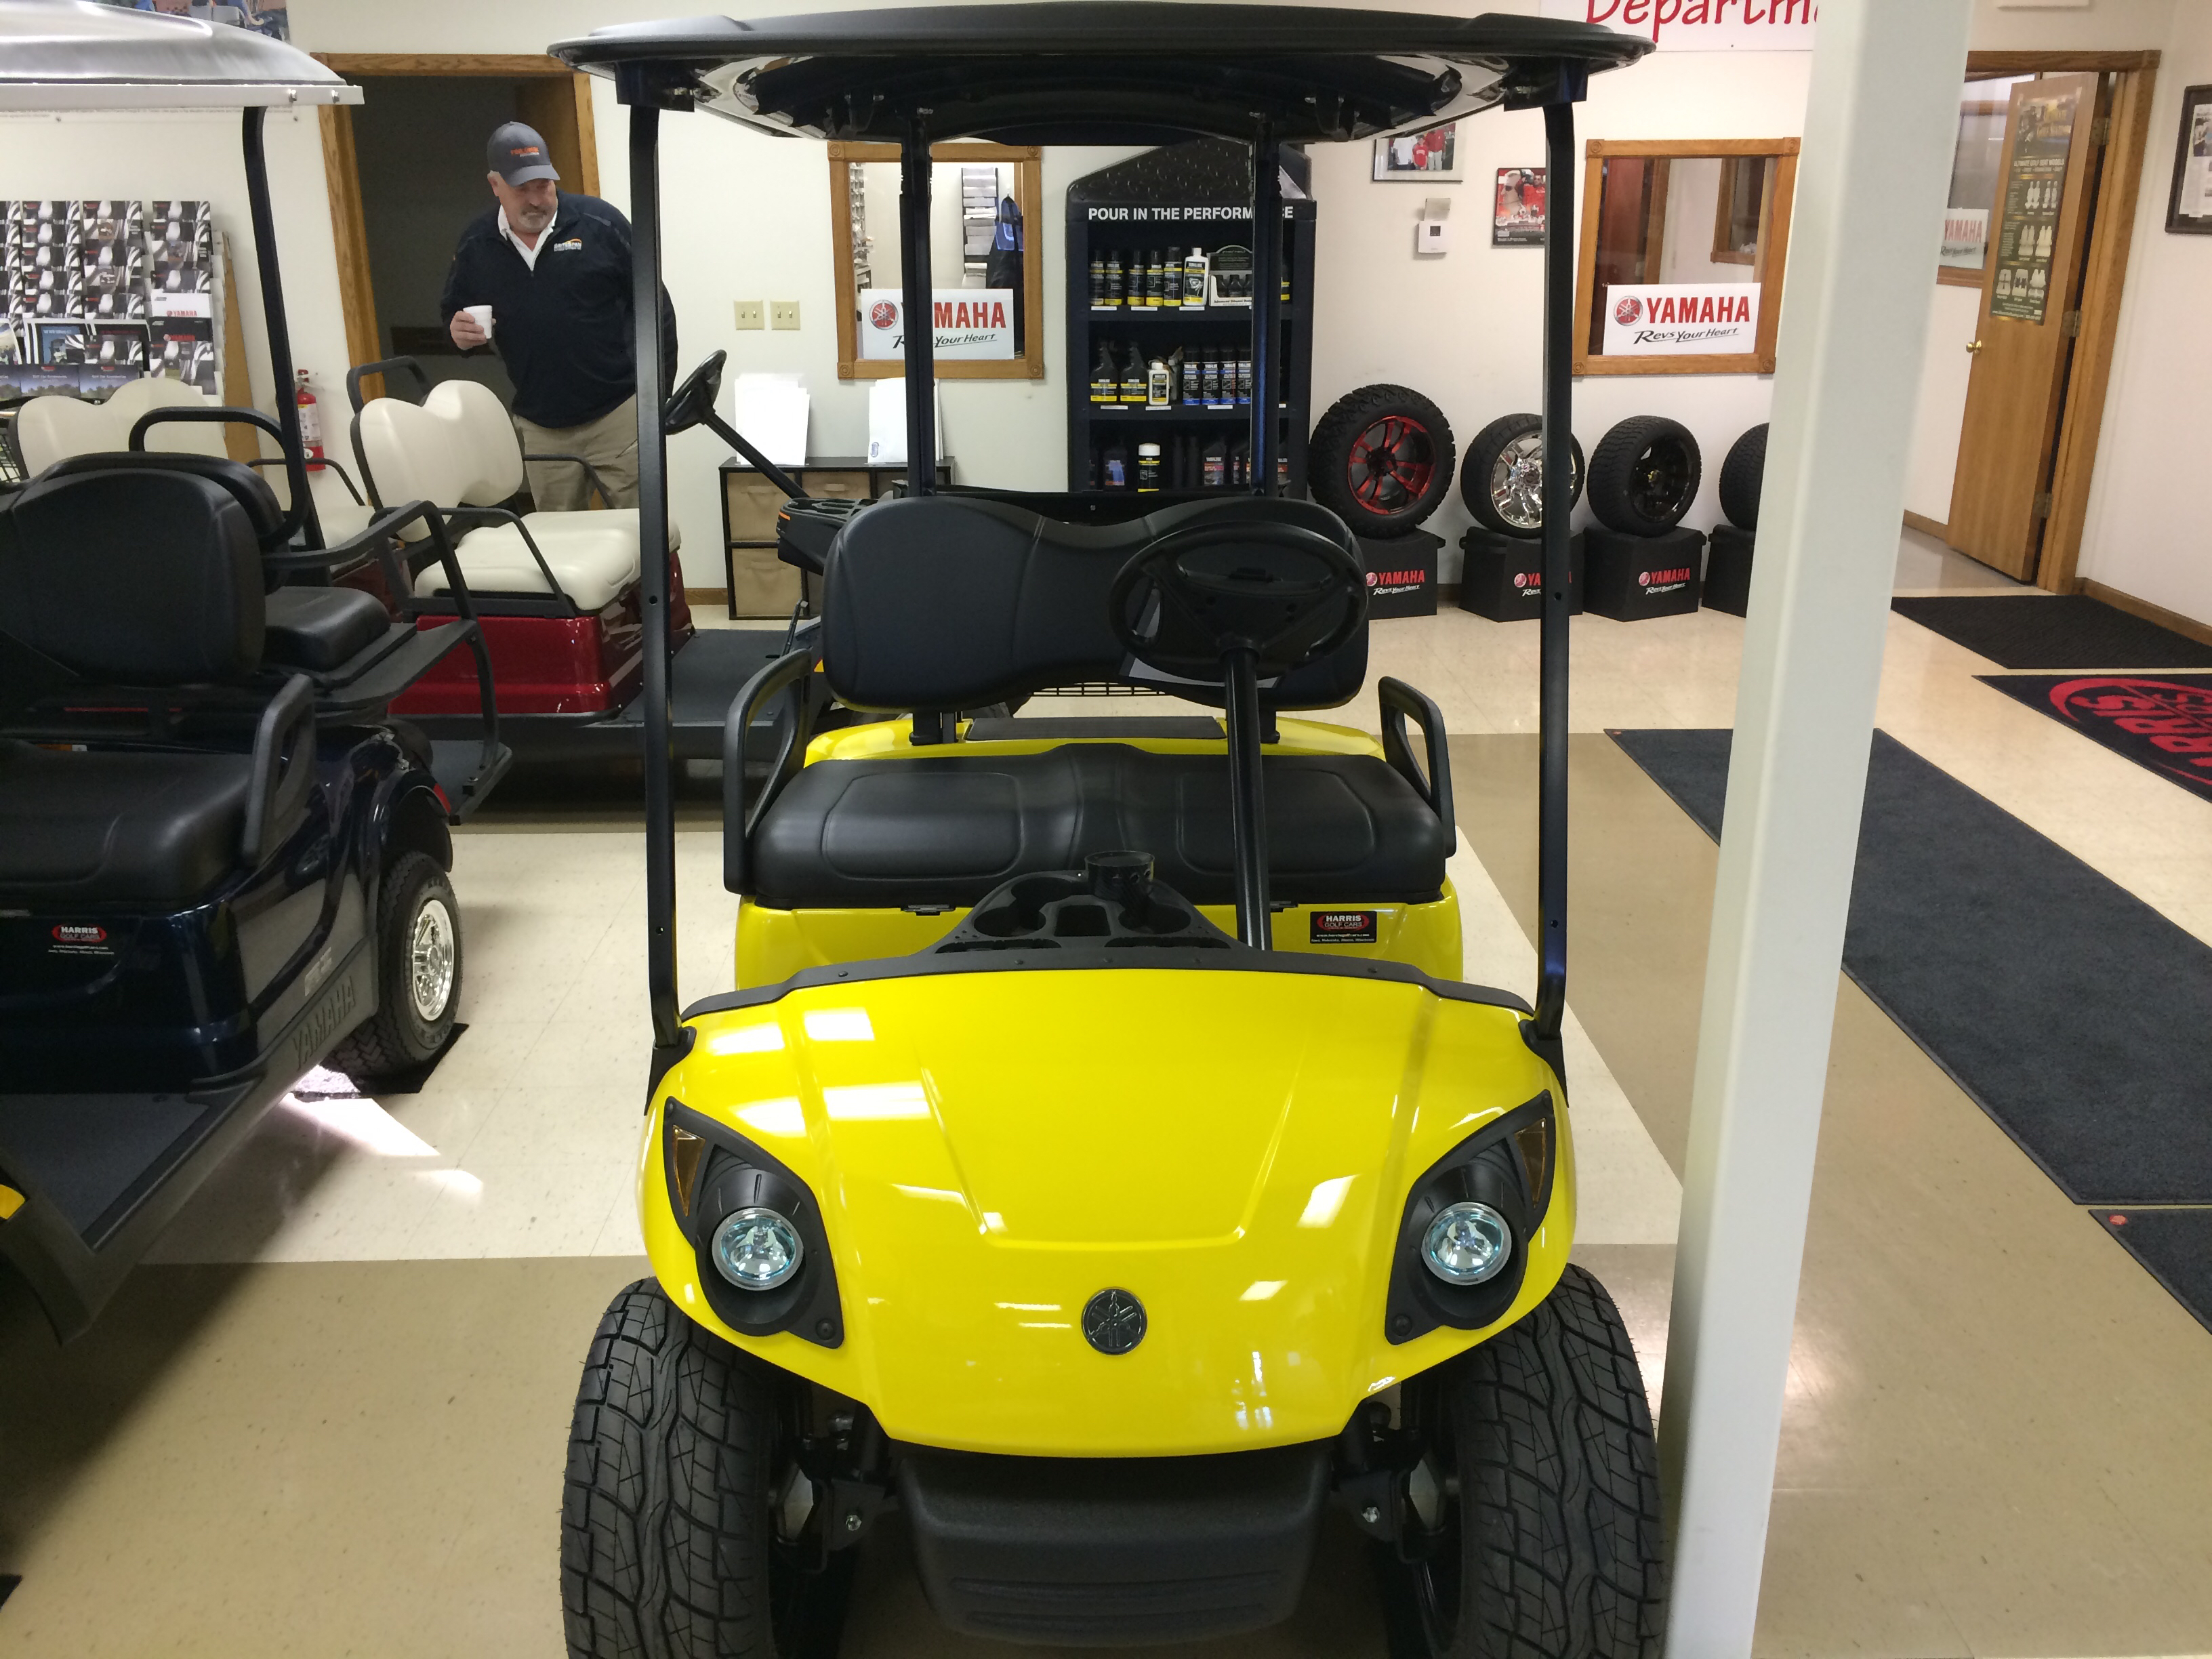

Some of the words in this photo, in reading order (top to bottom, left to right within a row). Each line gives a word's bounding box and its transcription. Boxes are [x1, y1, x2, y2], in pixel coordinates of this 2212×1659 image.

[1088, 208, 1128, 220] POUR
[1133, 208, 1147, 220] IN
[1151, 207, 1180, 220] THE
[901, 302, 1006, 329] MAHA
[1647, 296, 1750, 323] YAMAHA
[935, 335, 964, 348] Your
[964, 333, 996, 343] Heart
[1633, 329, 1676, 344] Revs
[1675, 330, 1705, 343] Your
[1706, 327, 1739, 337] Heart
[1378, 570, 1425, 585] YAMAHA
[1650, 568, 1690, 584] YAMAHA
[293, 975, 356, 1071] YAMAHA
